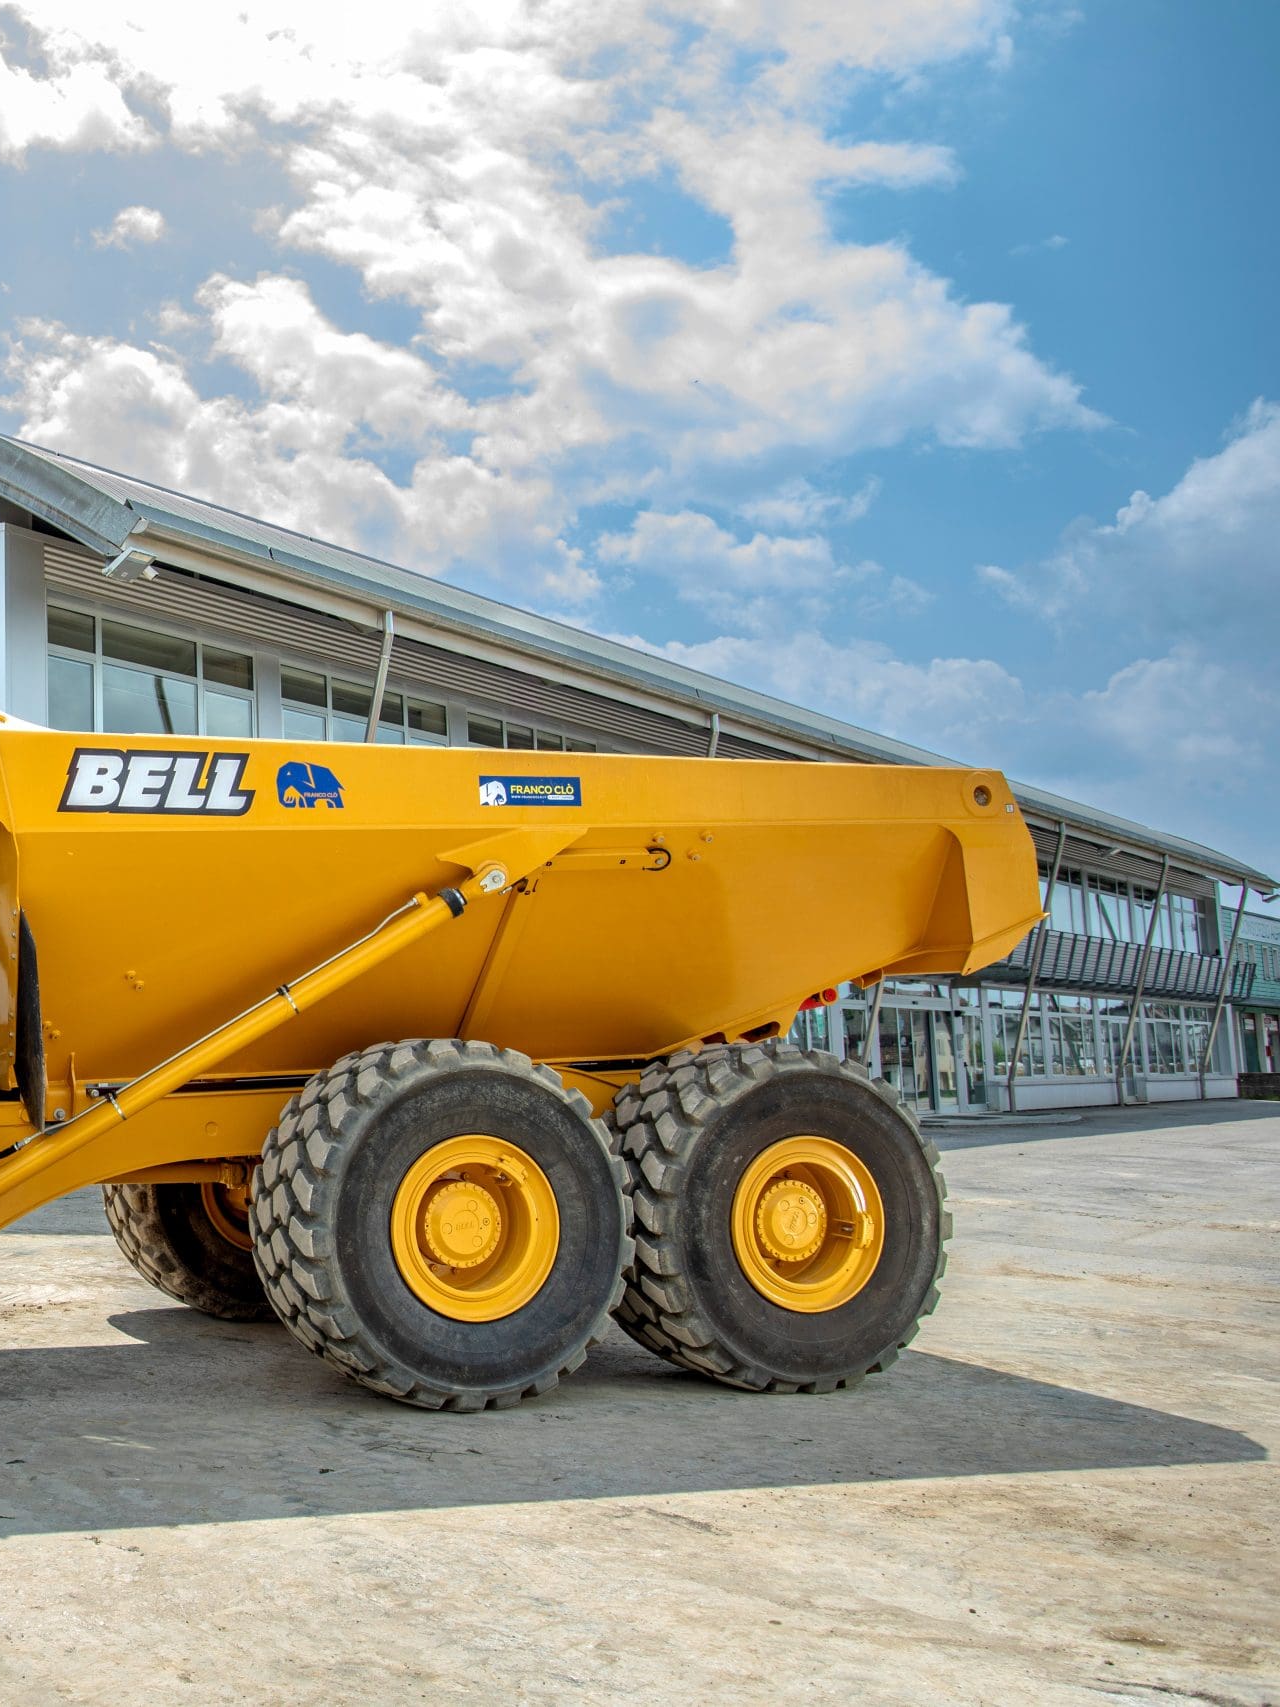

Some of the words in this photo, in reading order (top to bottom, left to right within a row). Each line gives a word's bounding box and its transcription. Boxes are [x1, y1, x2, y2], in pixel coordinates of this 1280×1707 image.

[59, 749, 253, 815] BELL
[510, 784, 552, 795] FRANCO
[554, 783, 574, 795] CLÒ
